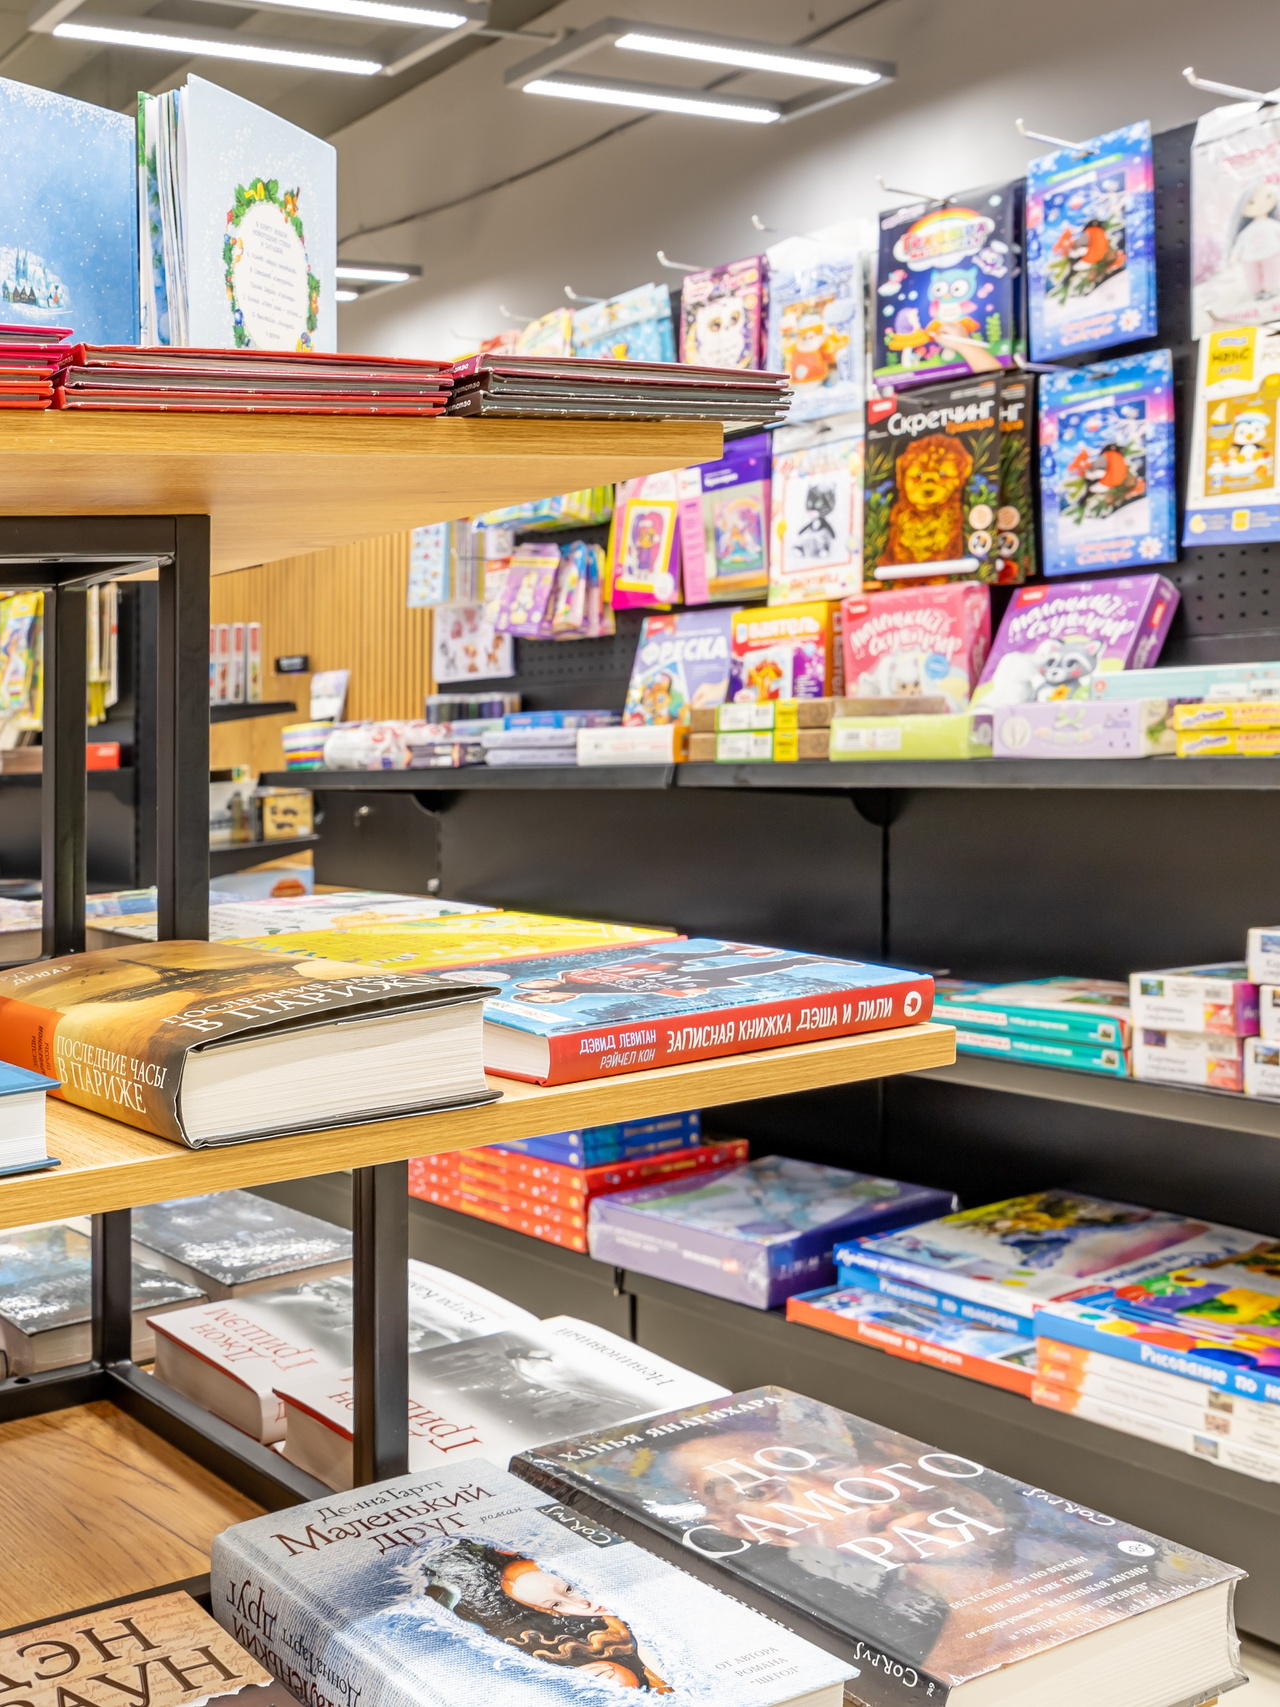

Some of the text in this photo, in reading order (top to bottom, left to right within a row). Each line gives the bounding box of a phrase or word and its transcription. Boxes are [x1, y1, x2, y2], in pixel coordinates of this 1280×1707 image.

[13, 965, 72, 986] ДРЮАР
[160, 983, 332, 1025] ПОСЛЕДНИЕ
[178, 976, 455, 1032] В ПАРИЖЕ
[666, 996, 894, 1053] ЗАПИСНАЯ КНИЖКА ДЭША И ЛИЛИ
[57, 1035, 168, 1089] ПОСЛЕДНИЕ ЧАСЫ
[579, 1029, 657, 1055] ДЭВИД ЛЕВИТАН
[599, 1048, 656, 1070] РЭЙЧЕЛ КОН
[57, 1057, 147, 1114] В ПАРИЖЕ
[557, 1394, 787, 1464] ХАНЬЯ ЯНАГИХАРА
[701, 1445, 817, 1495] ДО
[270, 1483, 498, 1557] Маленький
[316, 1480, 444, 1524] Донна Тартт
[479, 1506, 524, 1525] роман
[681, 1453, 985, 1559] САМОГО
[836, 1506, 1006, 1572] РАЯ
[949, 1582, 1014, 1610] БЕСТСЕЛЛЕР
[1029, 1569, 1048, 1580] ПО
[1046, 1555, 1089, 1574] ВЕРСИИ
[982, 1569, 1094, 1614] THE NEW YORK TIMES
[965, 1631, 977, 1639] от
[976, 1619, 1008, 1635] автора
[1007, 1606, 1044, 1625] романов
[1057, 1603, 1096, 1622] СРЕДИ
[231, 1613, 344, 1707] аленький
[714, 1646, 780, 1671] ОТ АВТОРА
[734, 1657, 789, 1678] РОМАНА
